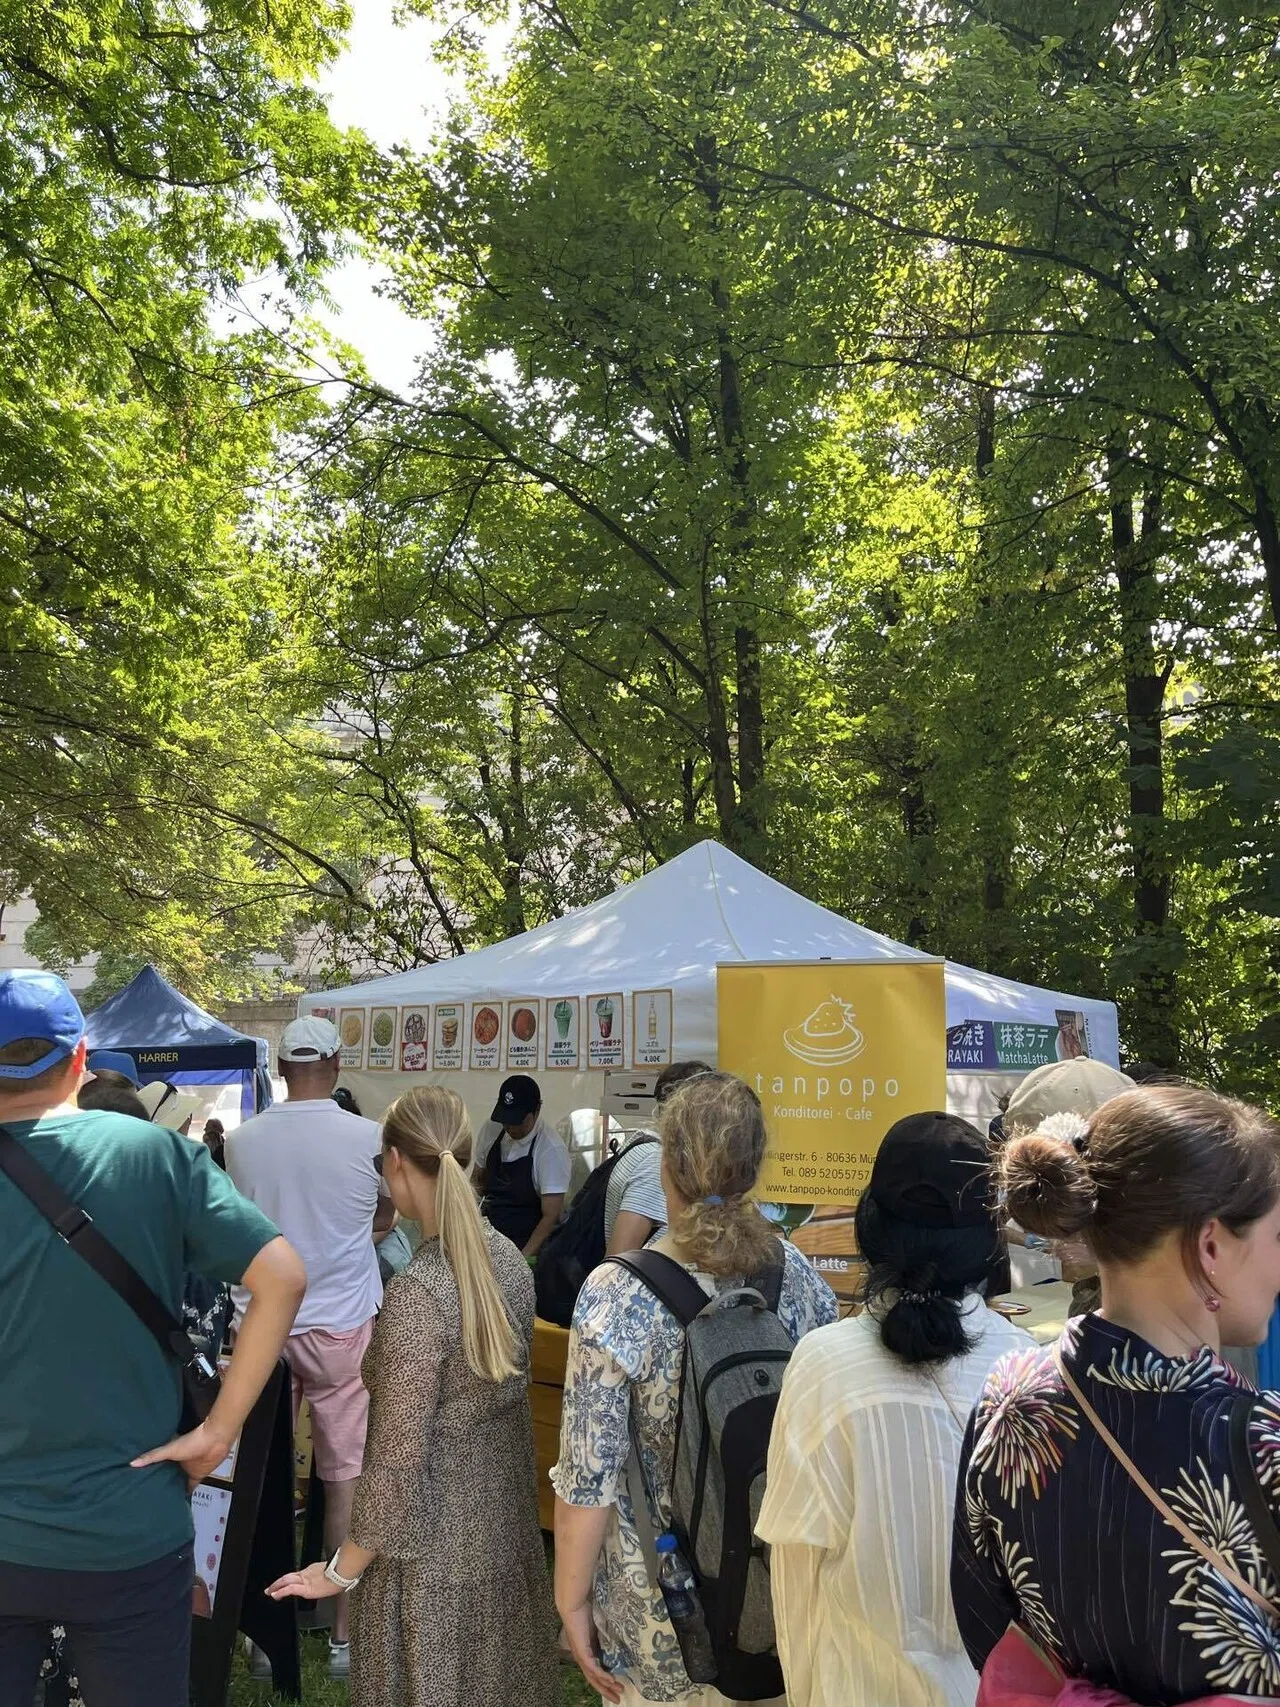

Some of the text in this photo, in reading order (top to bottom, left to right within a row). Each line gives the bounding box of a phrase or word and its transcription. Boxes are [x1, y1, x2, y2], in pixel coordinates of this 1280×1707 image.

[1000, 1024, 1049, 1048] 抹茶ラテ
[139, 1052, 179, 1063] HARRER
[598, 1057, 614, 1065] 7,00€
[644, 1055, 660, 1063] 4,00€
[755, 1072, 899, 1102] tanpopo
[774, 1105, 873, 1120] Konditorei Cafe
[811, 1151, 818, 1161] 6
[826, 1152, 857, 1164] 80636
[782, 1166, 796, 1177] Tel.
[798, 1167, 817, 1178] 089
[812, 1256, 848, 1270] Latte
